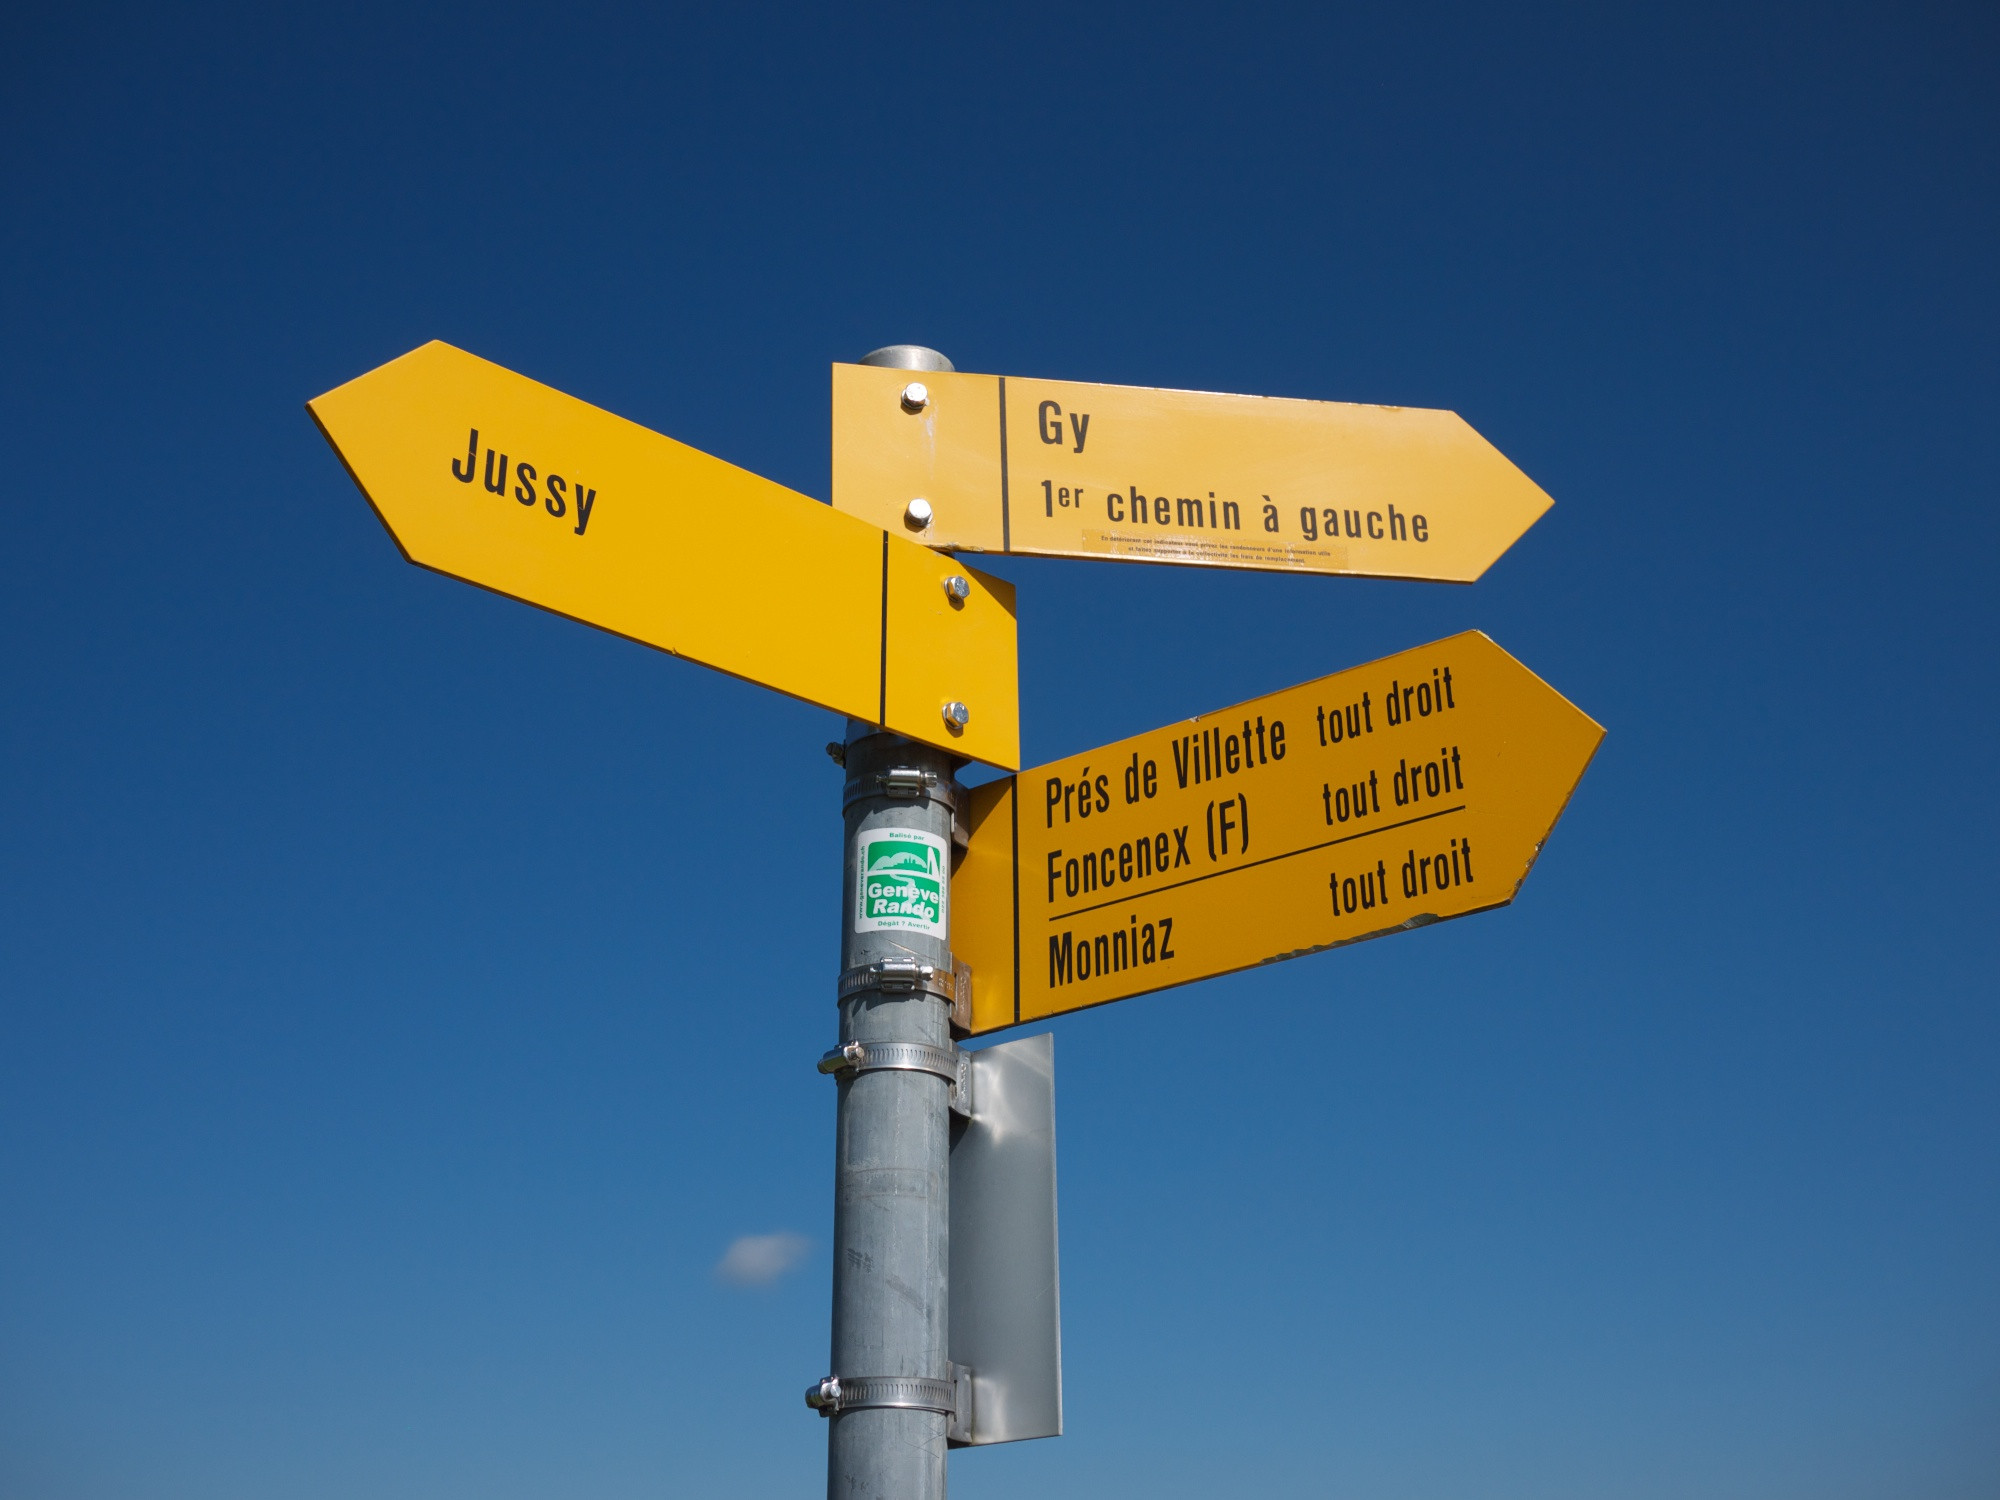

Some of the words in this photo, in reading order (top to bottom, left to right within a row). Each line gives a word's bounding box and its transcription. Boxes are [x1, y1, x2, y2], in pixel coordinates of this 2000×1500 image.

[1039, 401, 1090, 454] Gy
[452, 428, 597, 536] Jussy
[1041, 479, 1084, 517] 1er
[1107, 486, 1241, 530] chemin
[1262, 494, 1280, 533] à
[1301, 504, 1429, 542] gauche
[1047, 767, 1110, 829] Prés
[1125, 753, 1158, 805] de
[1172, 716, 1286, 790] Villette
[1316, 692, 1374, 747] tout
[1386, 667, 1455, 727] droit
[1048, 826, 1190, 903] Foncenex
[1207, 793, 1249, 862] (F)
[1323, 770, 1381, 826] tout
[1394, 746, 1464, 807] droit
[873, 898, 935, 920] Rando
[907, 921, 931, 930] Avertir
[1049, 914, 1175, 989] Monniaz
[1329, 861, 1389, 917] tout
[1401, 837, 1474, 899] droit
